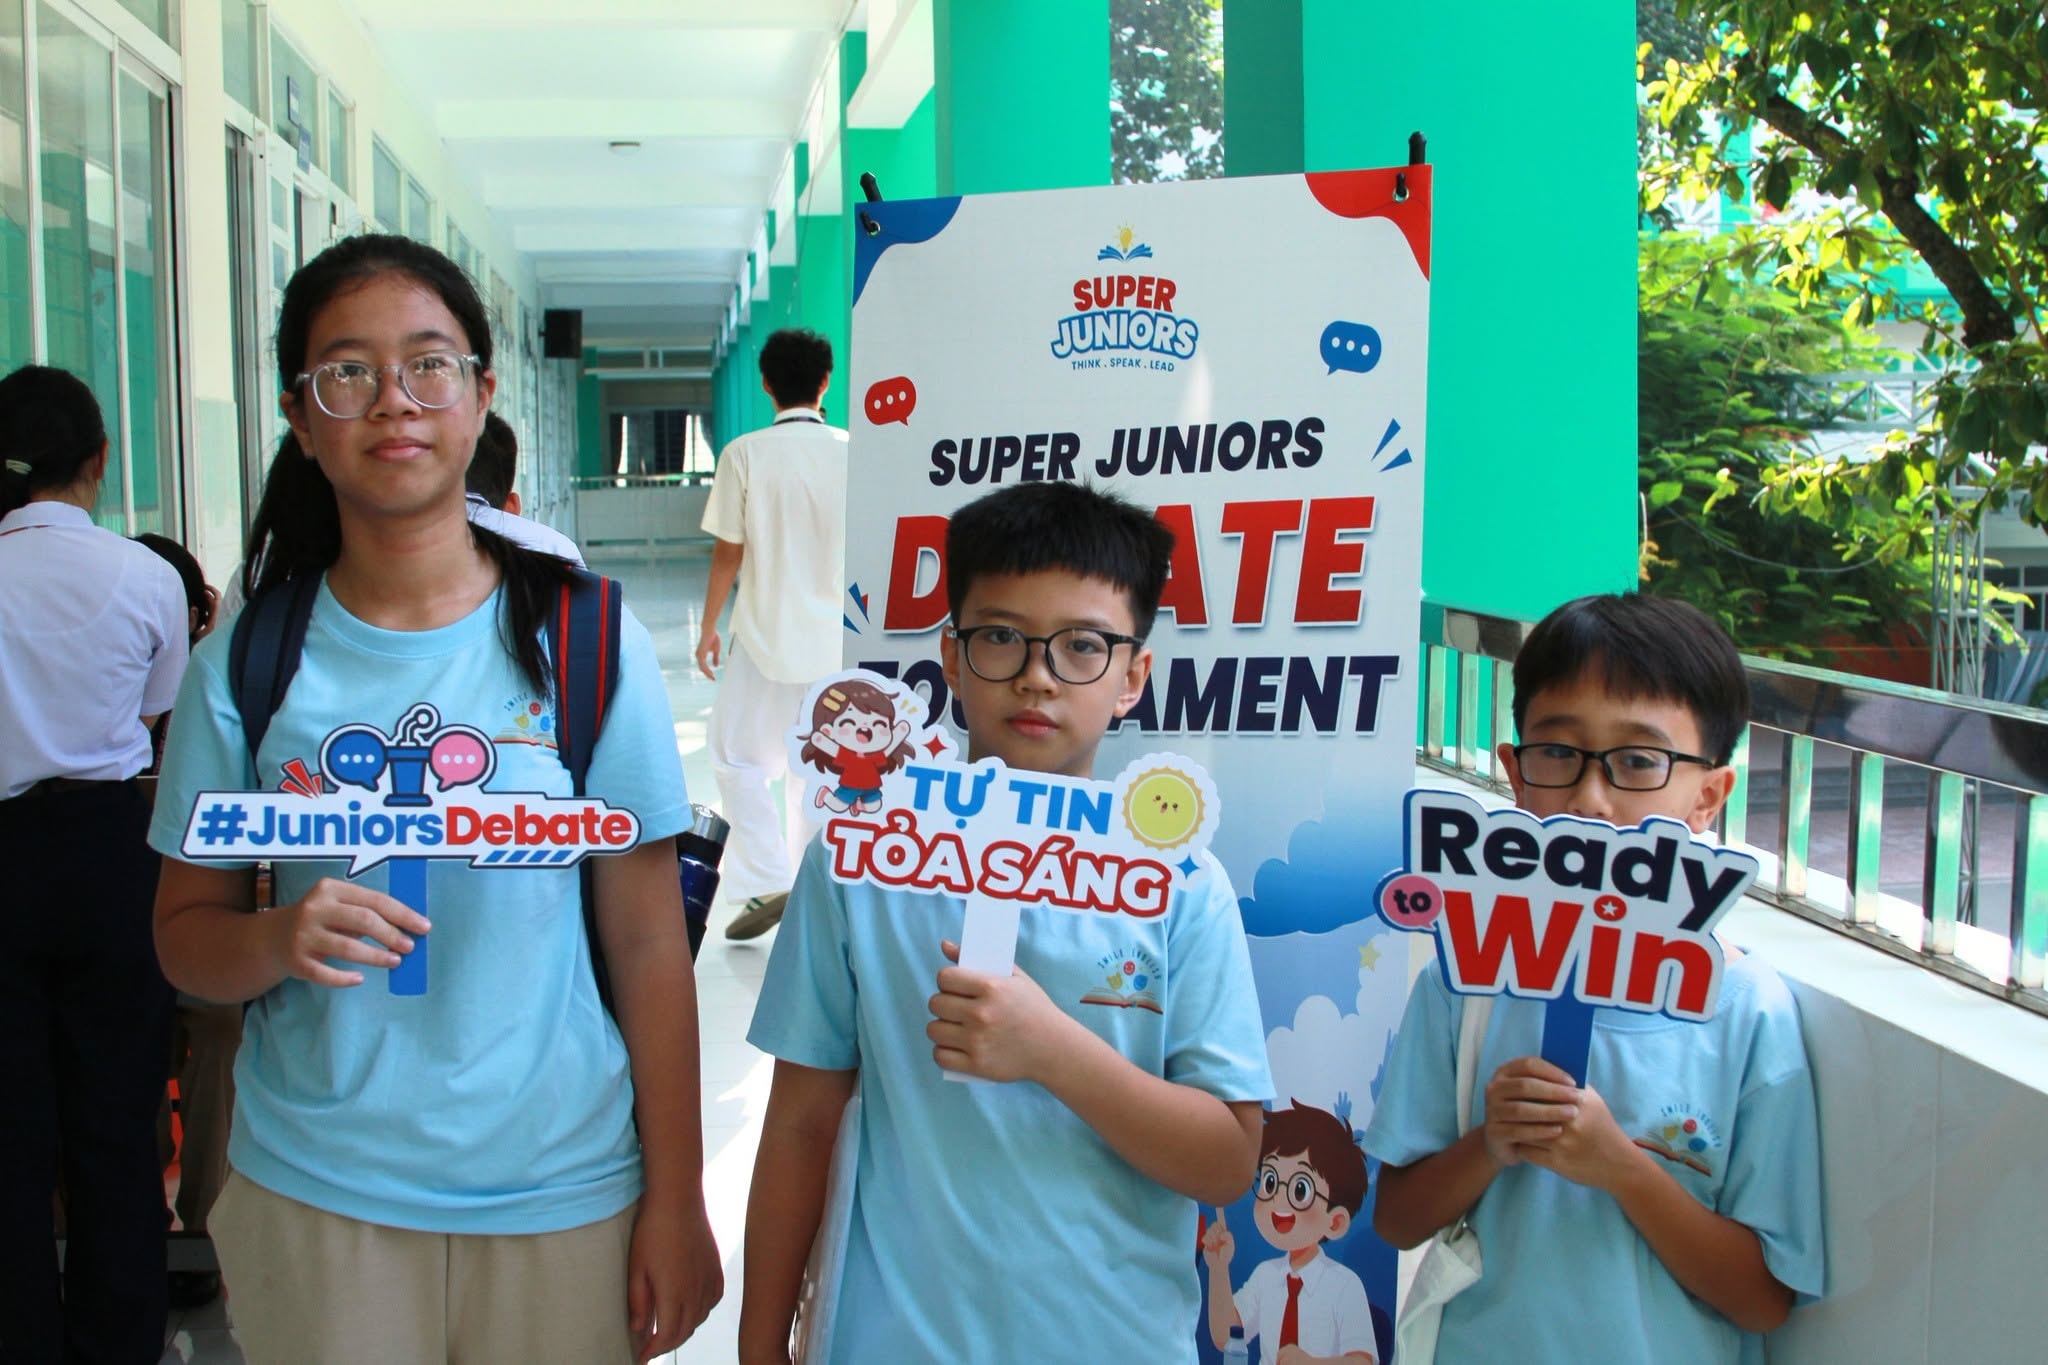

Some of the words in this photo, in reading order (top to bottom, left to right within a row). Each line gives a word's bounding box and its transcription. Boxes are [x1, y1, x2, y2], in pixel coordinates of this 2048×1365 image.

[1073, 275, 1177, 312] SUPER
[1051, 310, 1199, 359] JUNIORS
[1071, 359, 1101, 371] THINK
[1110, 358, 1141, 368] SPEAK
[1150, 360, 1175, 372] LEAD
[929, 432, 1081, 487] SUPER
[1095, 417, 1325, 478] JUNIORS
[883, 496, 1375, 635] DATE
[198, 800, 632, 847] #JuniorsDebate
[905, 764, 996, 829] TỰ
[1009, 779, 1113, 835] TIN
[827, 808, 974, 893] TỎA
[977, 834, 1172, 918] SÁNG
[1421, 806, 1747, 933] Ready
[1393, 888, 1432, 915] to
[1443, 890, 1713, 1015] Win
